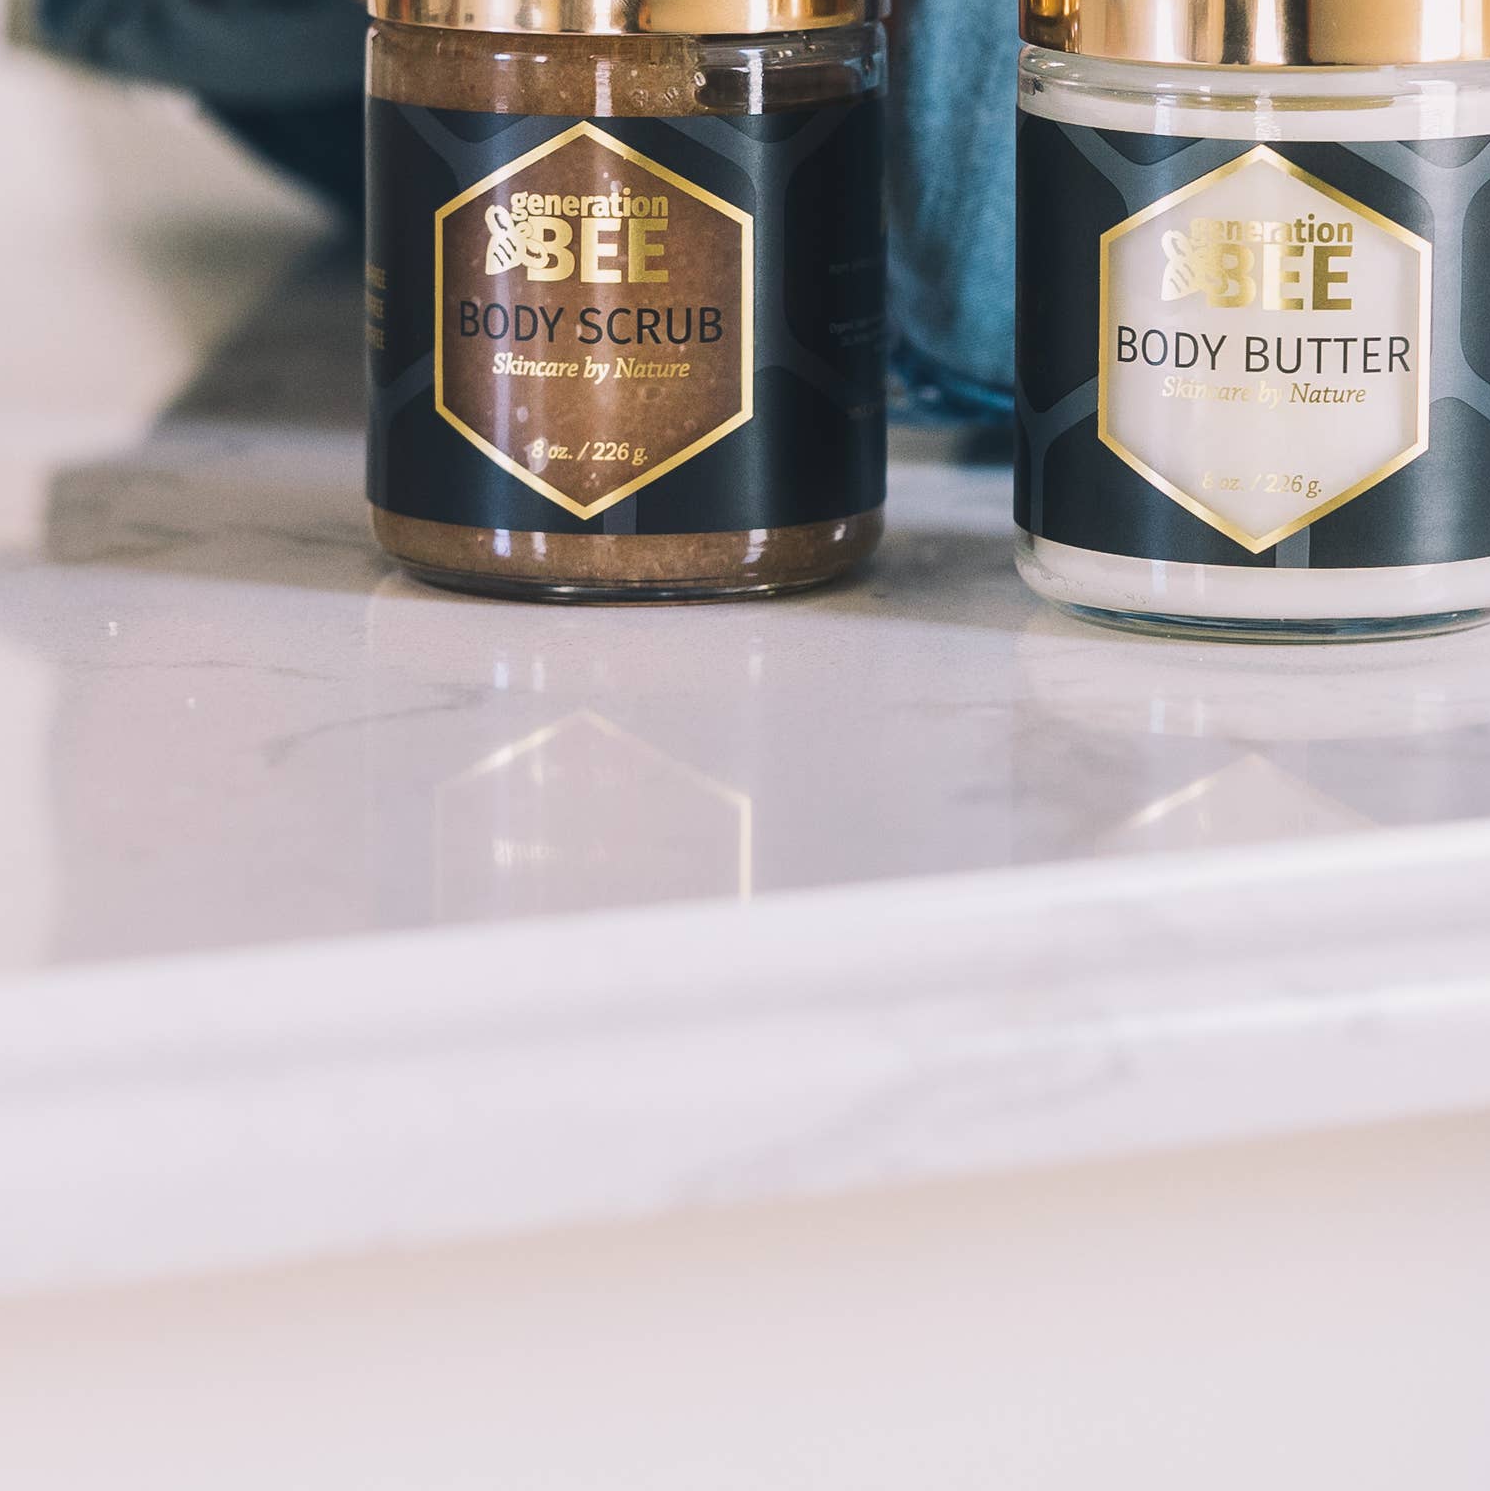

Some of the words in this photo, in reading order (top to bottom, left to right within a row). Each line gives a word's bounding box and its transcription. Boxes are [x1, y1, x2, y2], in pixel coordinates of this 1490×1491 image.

[510, 188, 669, 222] generation
[1190, 214, 1353, 250] generation
[525, 216, 669, 284] BEE
[1206, 243, 1354, 311] BEE
[459, 300, 565, 343] BODY
[578, 306, 724, 345] SCRUB
[1116, 324, 1228, 371] BODY
[1245, 334, 1412, 375] BUTTER
[492, 352, 579, 379] Skincare
[582, 355, 611, 385] by
[614, 357, 691, 379] Nature
[1161, 375, 1249, 402] Skinare
[1256, 380, 1284, 410] by
[1288, 382, 1367, 404] Nature
[530, 440, 545, 461] 8
[548, 445, 574, 461] oz.
[591, 441, 630, 462] 226
[1263, 473, 1304, 494] 226
